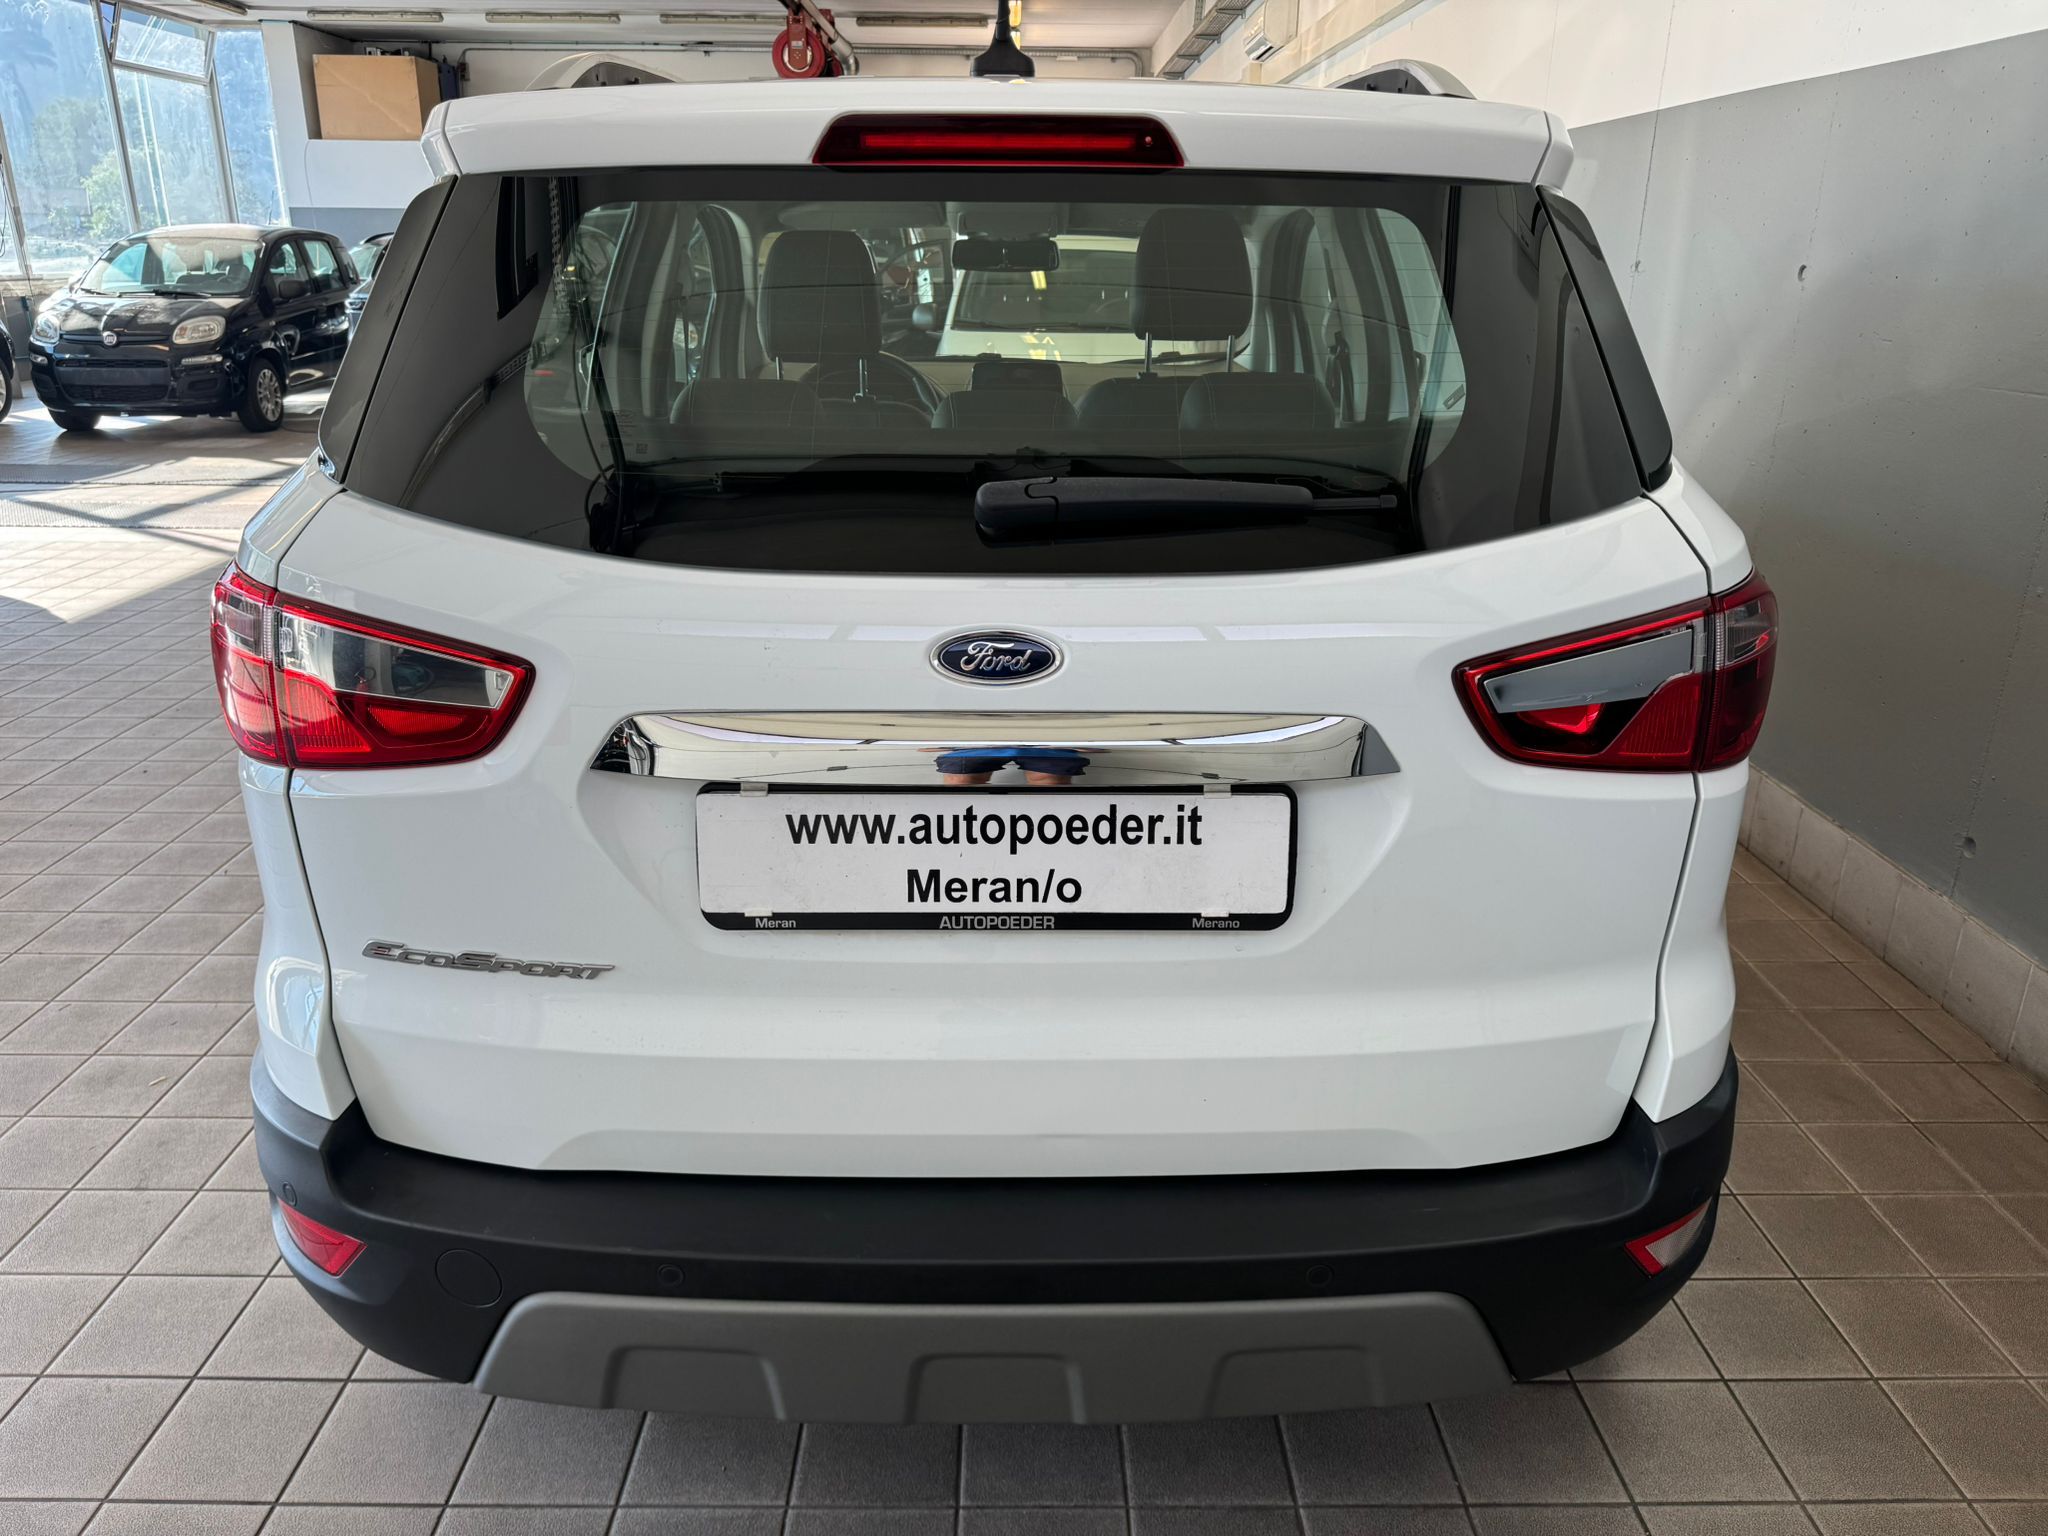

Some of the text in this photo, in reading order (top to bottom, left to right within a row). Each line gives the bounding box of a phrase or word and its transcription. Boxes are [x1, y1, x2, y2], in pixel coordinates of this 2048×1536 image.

[960, 641, 1033, 672] Ford
[785, 804, 1203, 854] www.autopoeder.it
[906, 868, 1083, 904] Meran/o
[755, 916, 796, 929] Meran
[939, 915, 1055, 930] AUTOPOEDER
[1192, 916, 1240, 930] Merano
